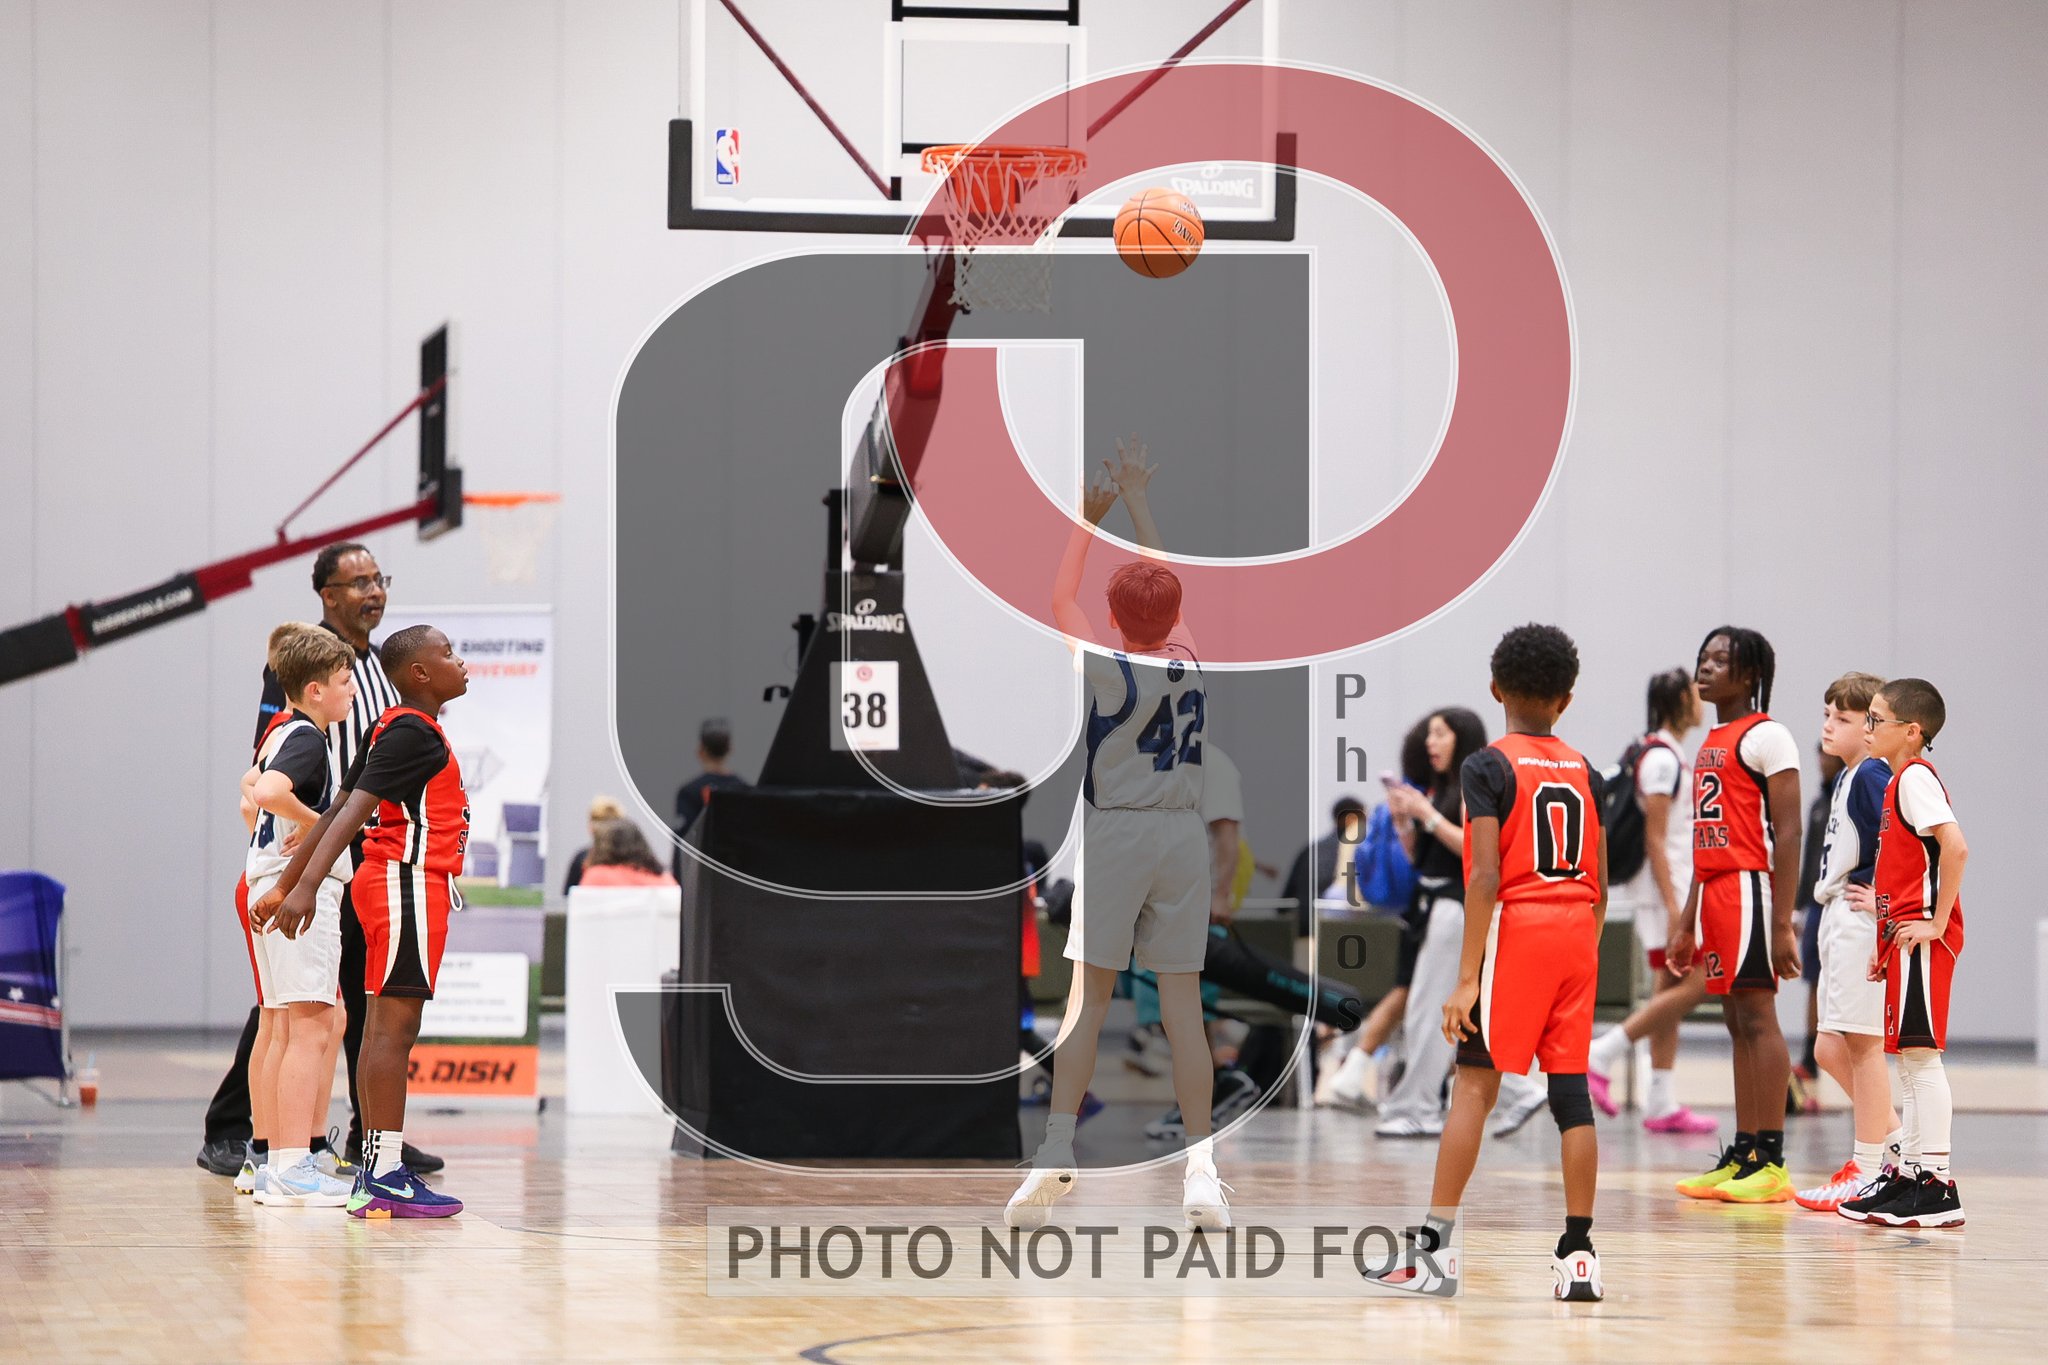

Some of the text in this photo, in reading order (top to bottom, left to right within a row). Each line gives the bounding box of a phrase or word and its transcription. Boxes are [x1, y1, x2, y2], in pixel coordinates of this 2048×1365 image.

[1170, 177, 1255, 199] SPALDING
[826, 612, 905, 634] SPALDING
[843, 693, 887, 728] 38
[1136, 689, 1205, 772] 42
[1532, 781, 1586, 883] 0
[1704, 951, 1724, 979] 12
[430, 1060, 517, 1083] DISH
